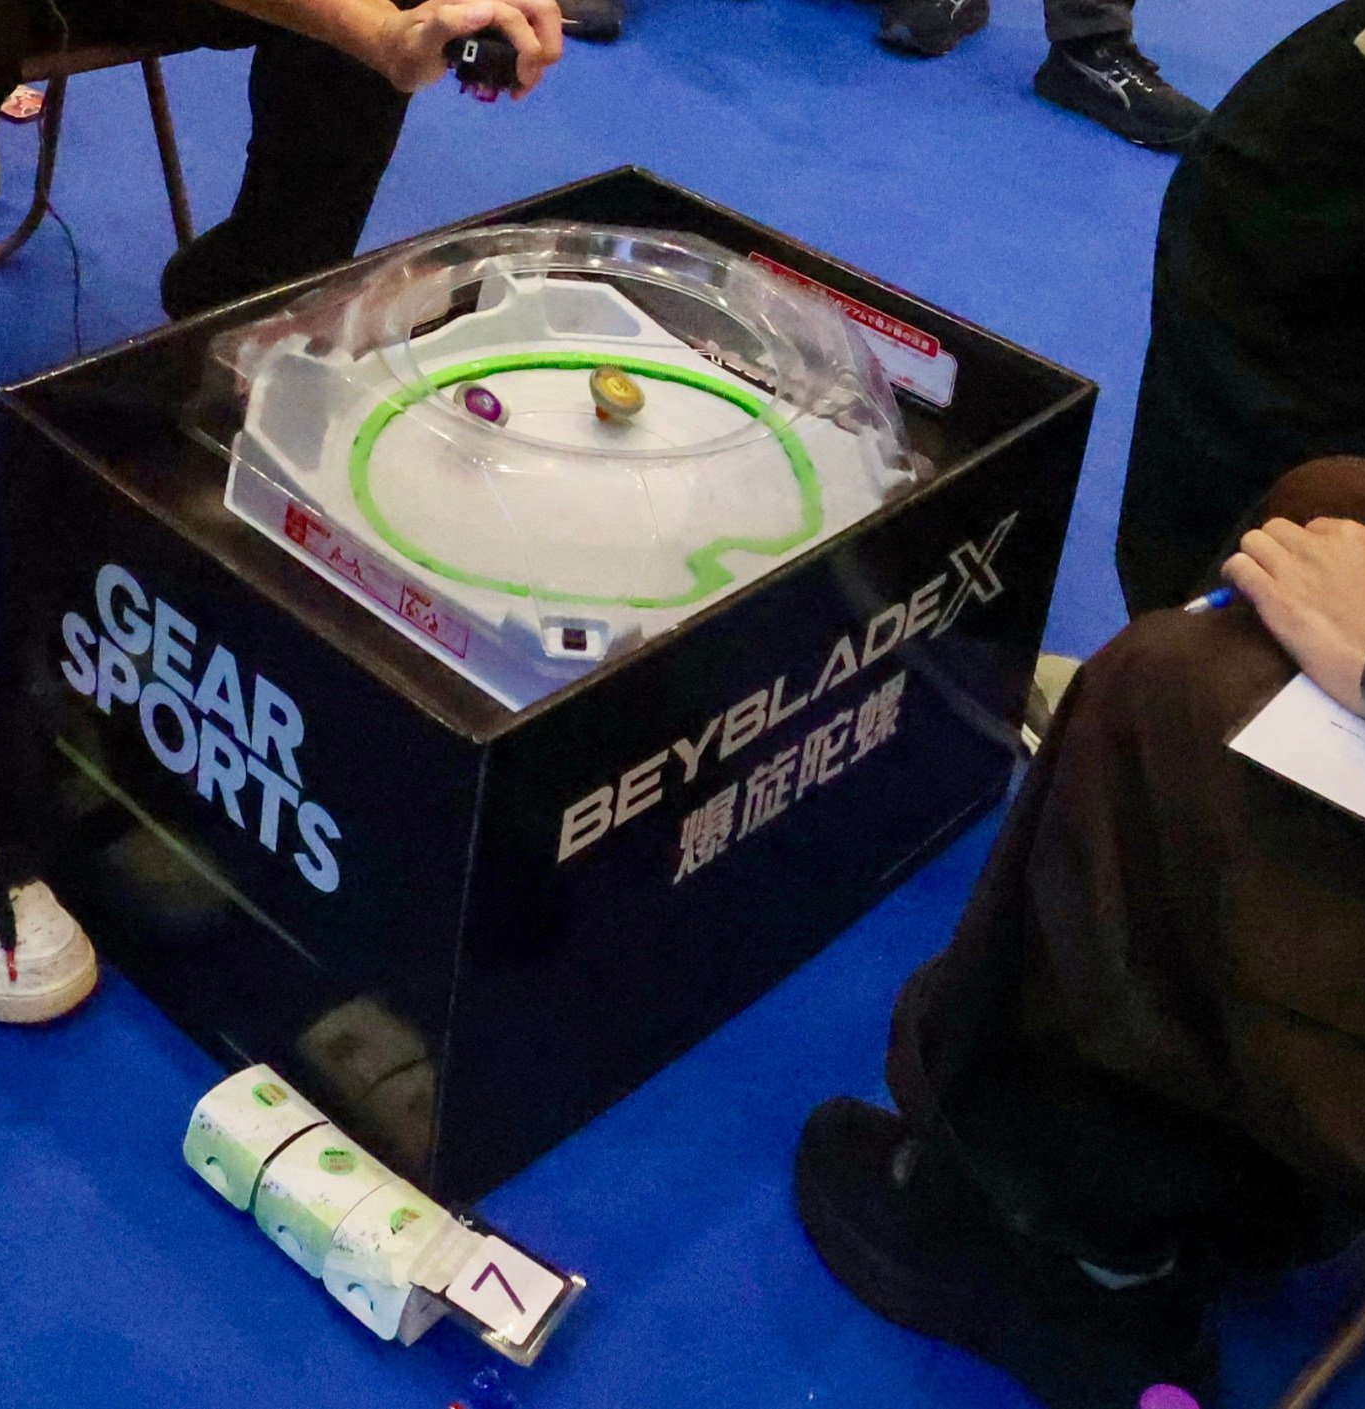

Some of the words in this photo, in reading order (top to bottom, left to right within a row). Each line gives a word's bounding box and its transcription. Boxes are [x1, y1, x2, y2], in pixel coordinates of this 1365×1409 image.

[60, 610, 343, 893] SPORTS
[95, 563, 305, 790] GEAR
[672, 669, 907, 886] 爆旋陀螺
[470, 1261, 527, 1316] 7
